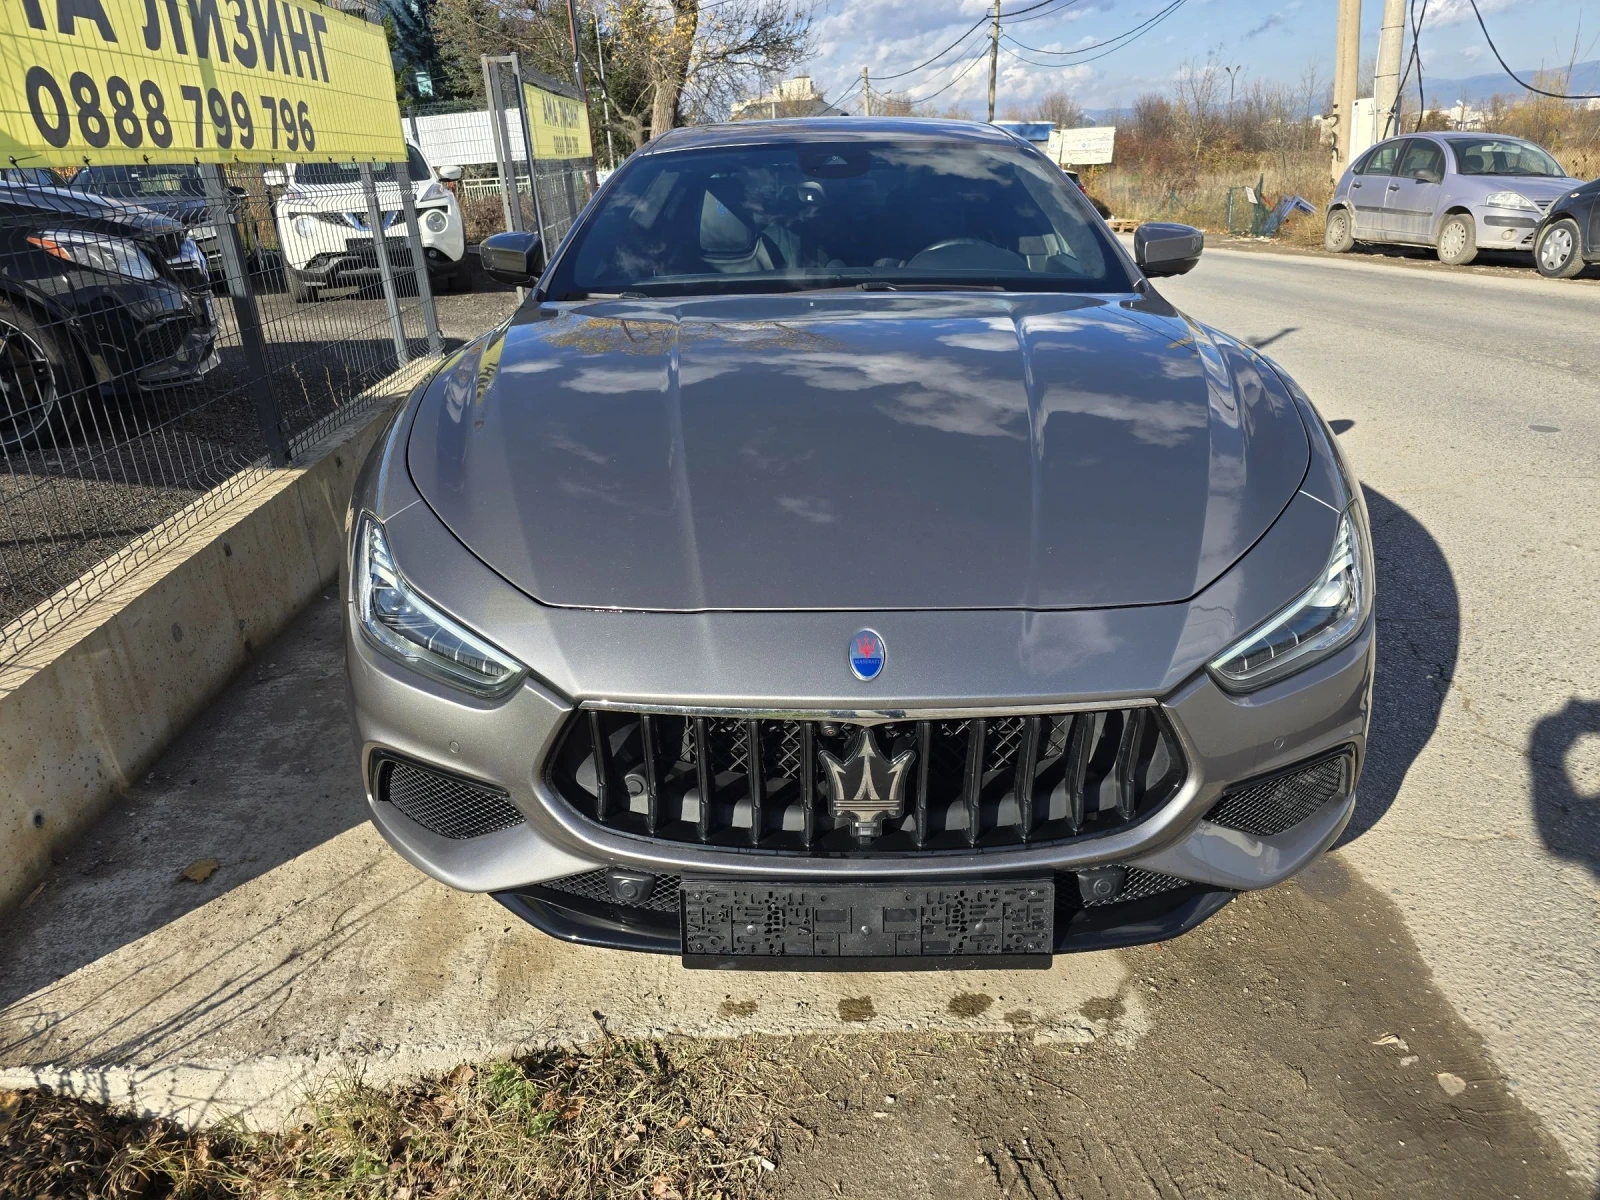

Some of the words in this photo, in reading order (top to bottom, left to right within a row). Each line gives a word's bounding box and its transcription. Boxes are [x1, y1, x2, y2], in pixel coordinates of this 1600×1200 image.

[142, 0, 330, 83] ЛИЗИНГ
[25, 65, 173, 149] 0888
[180, 84, 254, 150] 799
[260, 95, 315, 152] 796
